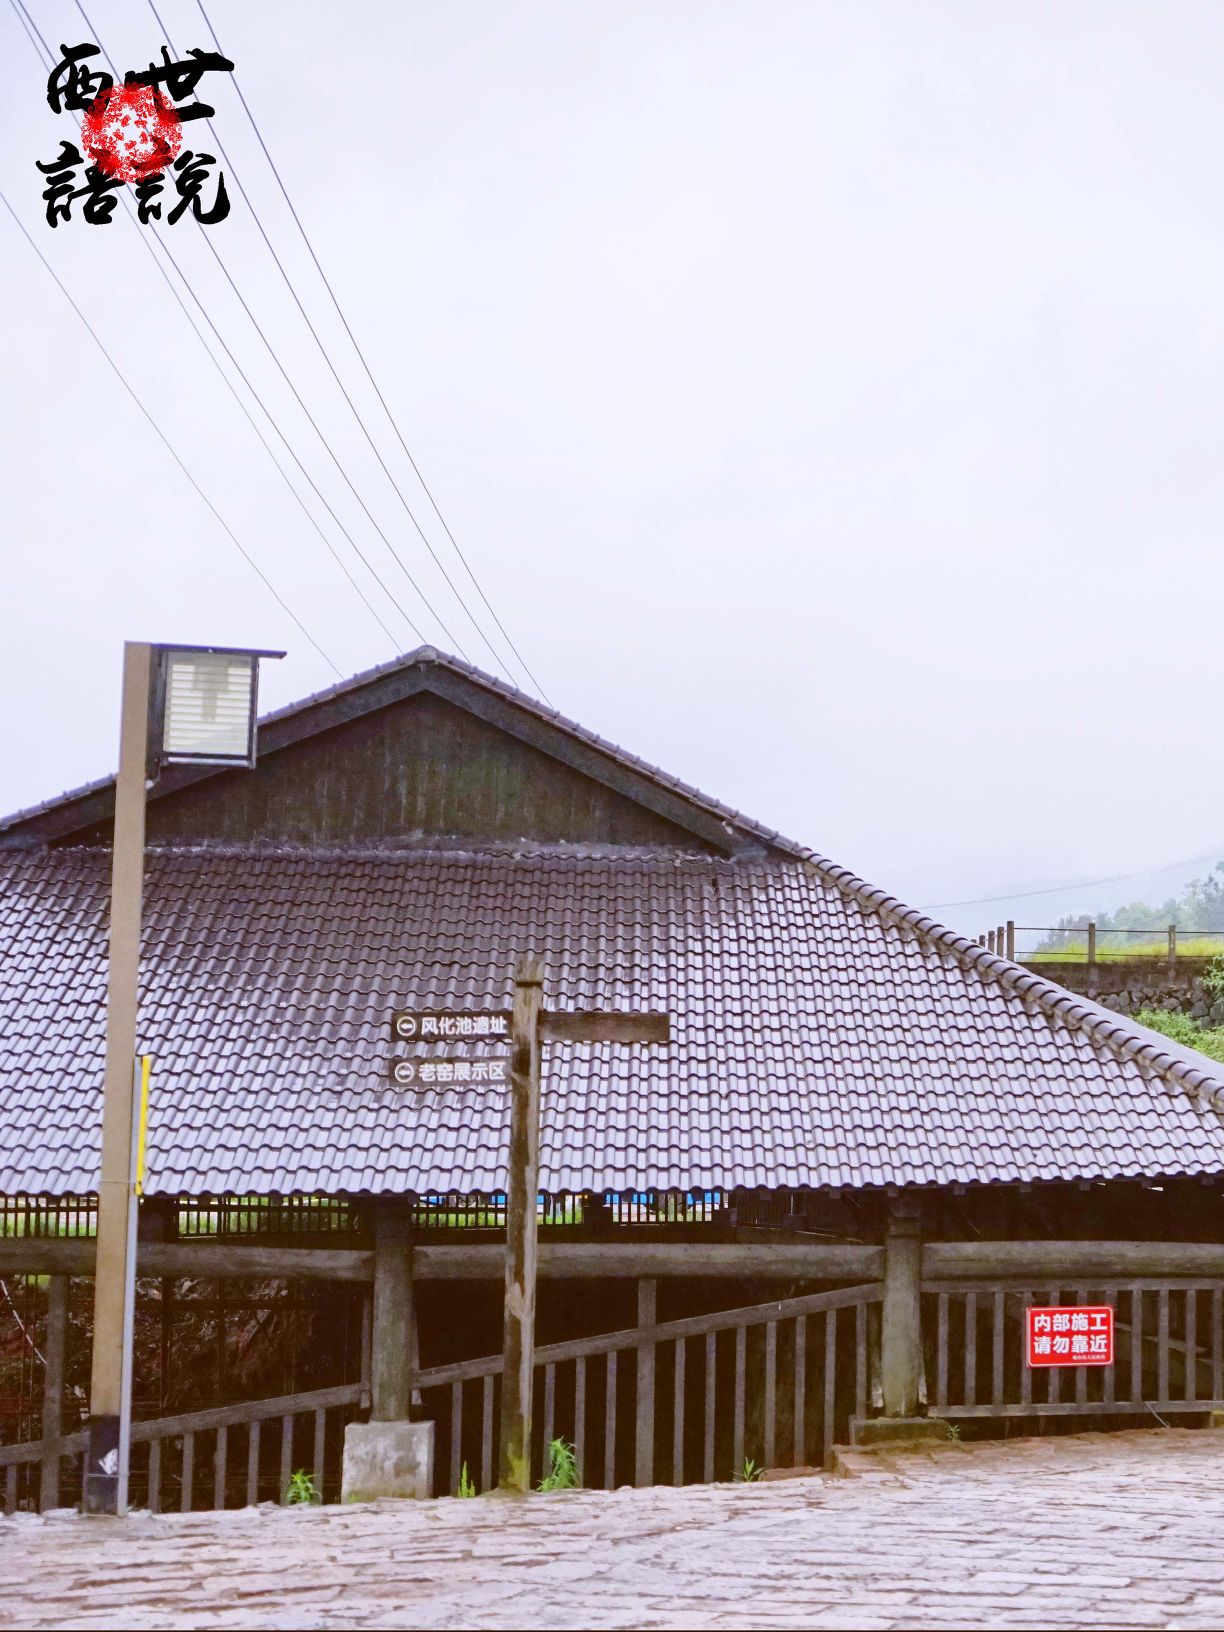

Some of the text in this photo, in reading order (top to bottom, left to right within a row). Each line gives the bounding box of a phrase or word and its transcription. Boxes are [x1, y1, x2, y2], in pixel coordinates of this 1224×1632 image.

[418, 1062, 506, 1082] 老窑展示区
[1033, 1313, 1108, 1332] 内部施工
[1033, 1335, 1108, 1354] 请勿靠近
